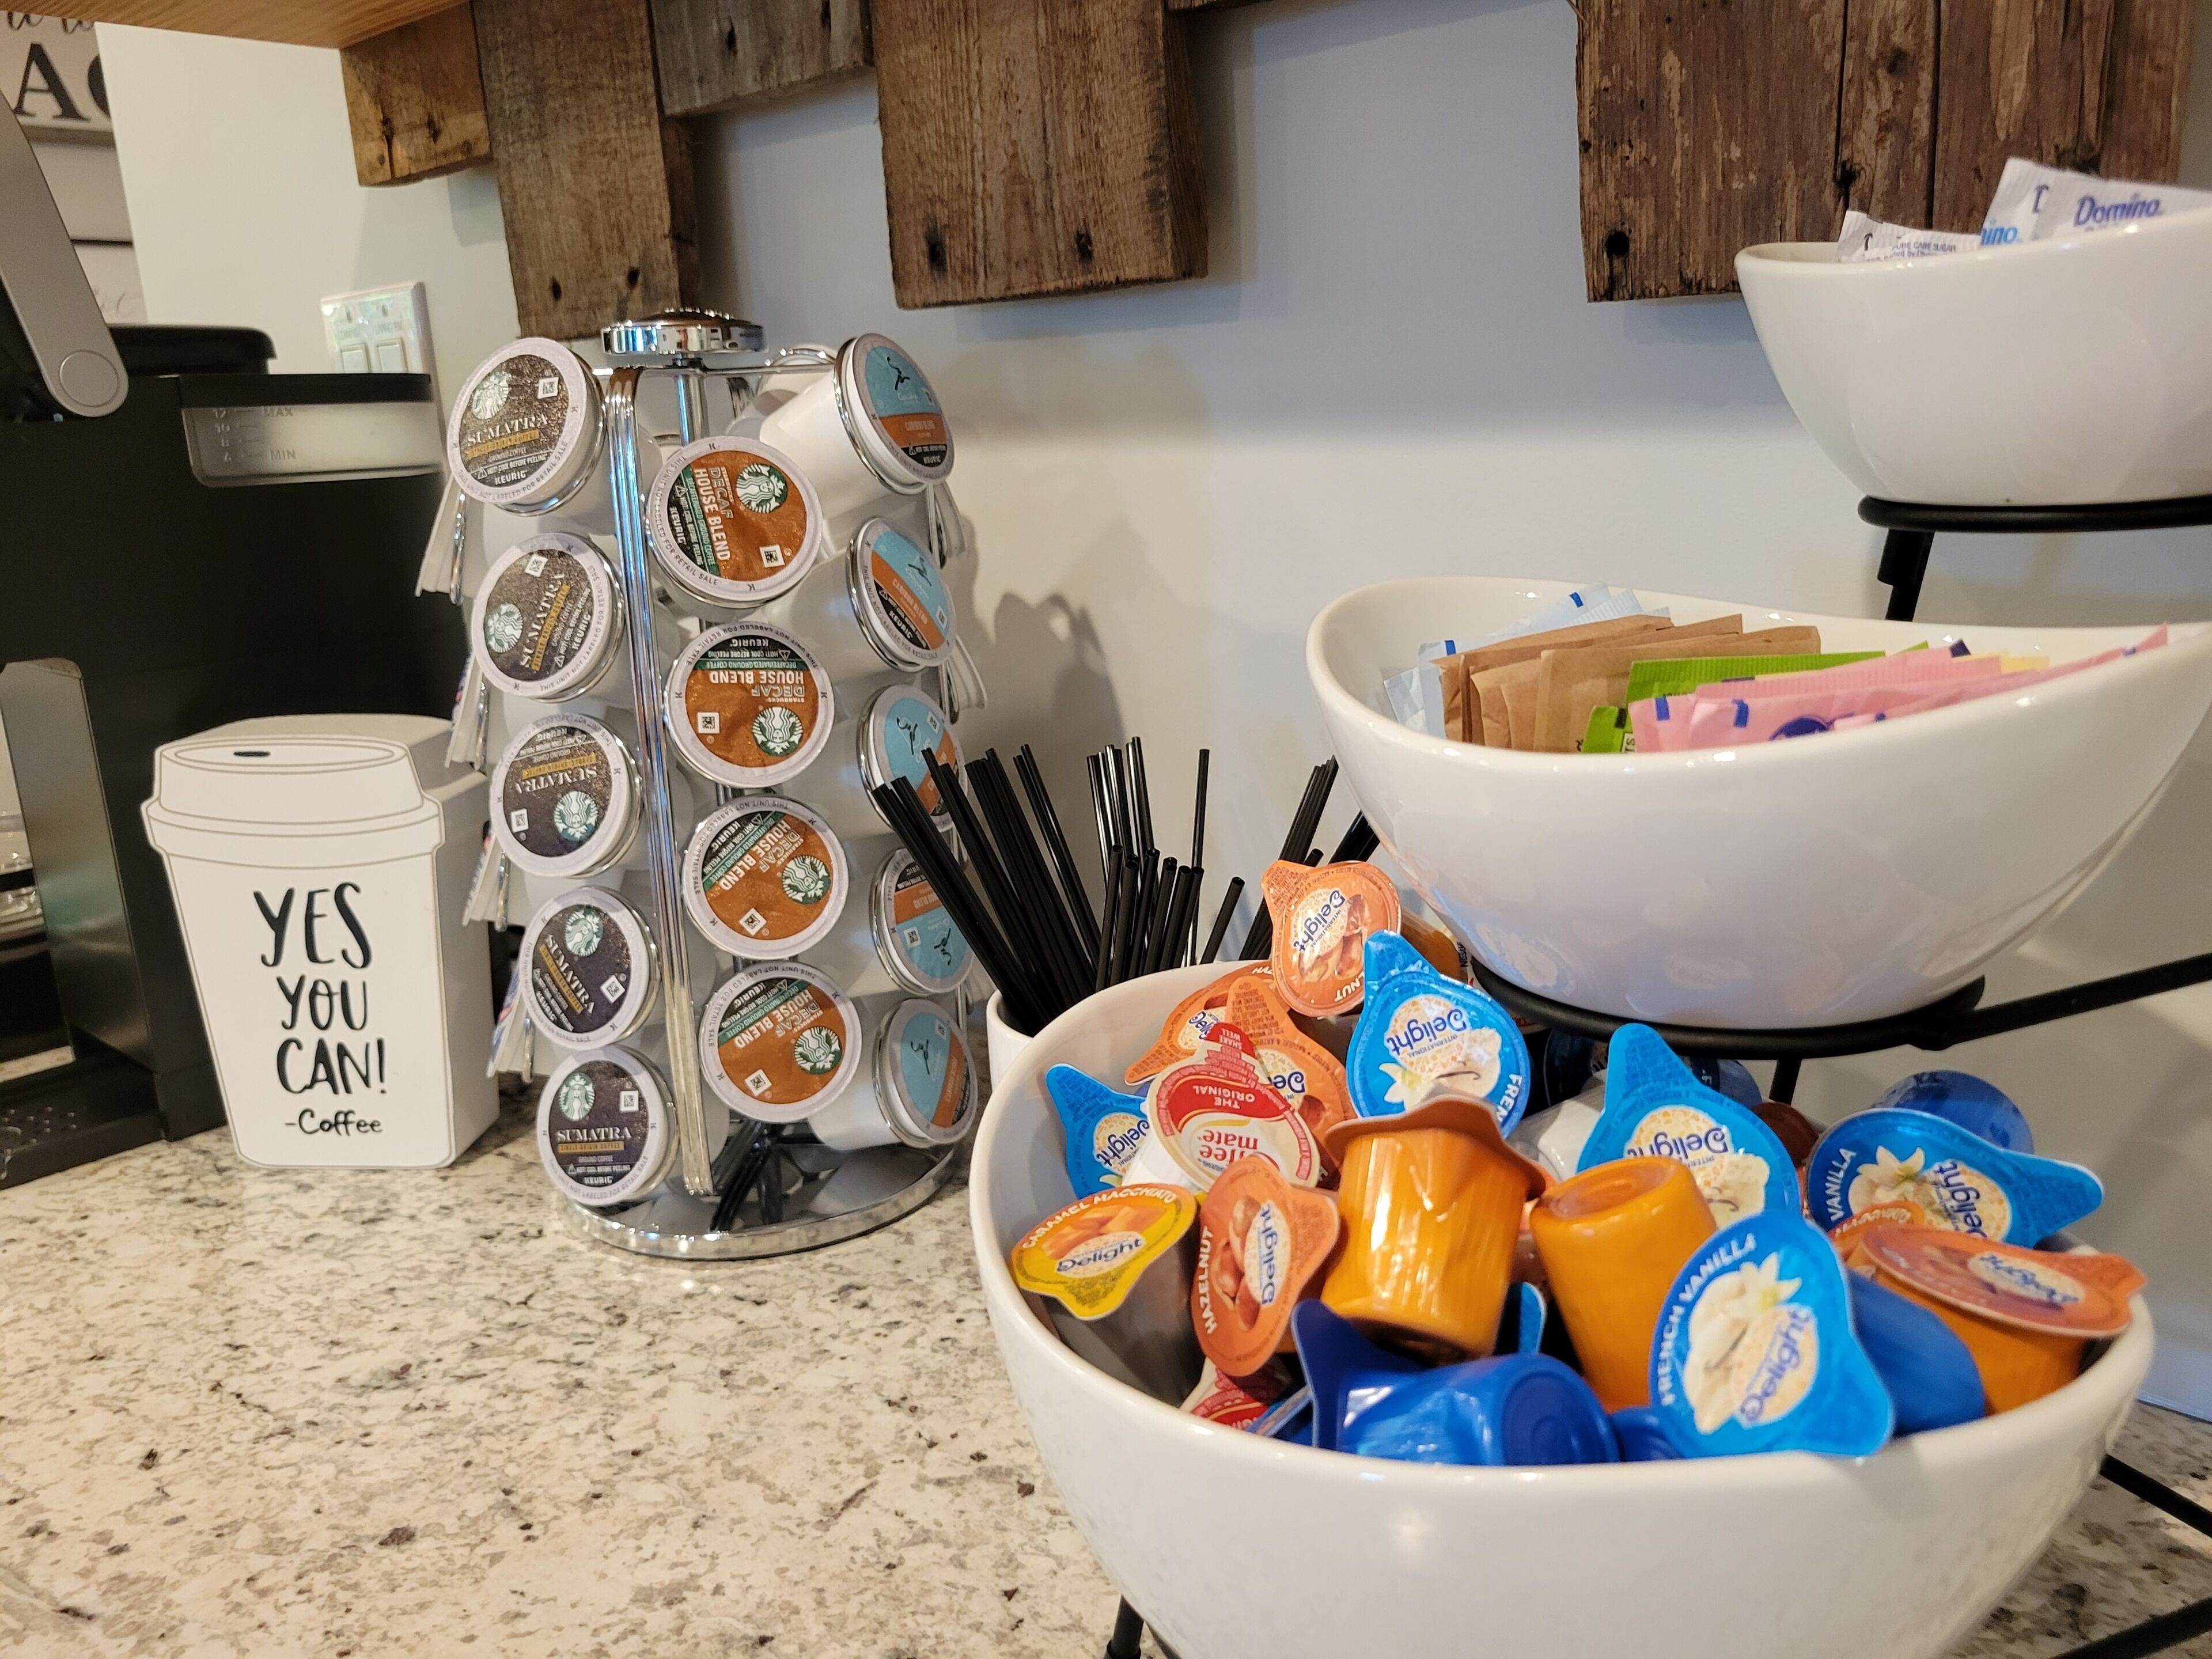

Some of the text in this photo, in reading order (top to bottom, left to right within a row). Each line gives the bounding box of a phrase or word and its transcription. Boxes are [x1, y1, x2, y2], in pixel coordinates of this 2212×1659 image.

[2073, 193, 2162, 226] Domino
[264, 407, 293, 417] MAX
[467, 414, 548, 446] SUMATRA
[270, 448, 297, 460] MIN
[522, 441, 568, 493] FOR RETAIL SALE
[495, 471, 527, 485] KEURIG
[708, 467, 734, 519] DECAF
[669, 506, 687, 544] KEURIG
[694, 468, 731, 561] HOUSE BLEND
[588, 565, 600, 582] SALE
[664, 538, 676, 555] FOR
[674, 555, 697, 577] RETAIL
[698, 574, 718, 586] SALE
[596, 583, 605, 607] RETAIL
[572, 612, 592, 650] KEURIG
[701, 632, 722, 649] RETAIL
[723, 626, 738, 634] FOR
[730, 638, 769, 647] KEURIG
[790, 639, 806, 653] UNIT
[806, 653, 819, 669] THIS
[709, 670, 804, 684] HOUSE BLEND
[751, 684, 805, 698] DECAF
[537, 728, 568, 742] KEURIG
[735, 801, 751, 811] NOT
[772, 800, 788, 809] THIS
[711, 821, 741, 852] KEURIG
[734, 832, 746, 845] COOL
[743, 823, 754, 836] HOT!
[719, 820, 791, 891] HOUSE BLEND
[759, 831, 800, 873] DECAF
[692, 876, 701, 895] SALE
[253, 881, 372, 969] YES
[1293, 889, 1346, 952] Delight
[1311, 909, 1342, 948] INTERNATIONAL
[800, 969, 817, 979] THIS
[276, 974, 368, 1031] YOU
[734, 982, 766, 1007] KEURIG
[734, 988, 813, 1049] HOUSE BLEND
[775, 1000, 820, 1037] DECAF
[1219, 1035, 1243, 1050] SHAKE
[1221, 1028, 1241, 1041] WELL
[1386, 1009, 1468, 1056] Delight
[1407, 1034, 1458, 1059] INTERNATIONAL
[276, 1037, 387, 1095] CAN!
[1192, 1085, 1256, 1103] ORIGINAL
[1214, 1097, 1241, 1109] THE
[1497, 1074, 1523, 1122] FREN
[285, 1108, 382, 1137] -Coffee
[556, 1127, 632, 1142] SUMATRA
[1200, 1130, 1259, 1150] mate
[1199, 1144, 1246, 1165] ffee
[582, 1190, 608, 1199] LABELED
[609, 1187, 621, 1197] FOR
[638, 1155, 649, 1172] SALE
[584, 1176, 613, 1184] KEURIG
[1826, 1147, 1857, 1222] VANILLA
[1022, 1201, 1091, 1249] CARAMEL
[1093, 1186, 1178, 1204] MACCHIATO
[1056, 1238, 1143, 1272] Delight
[1260, 1202, 1278, 1305] Delight
[1198, 1226, 1218, 1335] HAZELNUT
[1657, 1305, 1684, 1406] FRENCH
[1739, 1308, 1811, 1422] Delight
